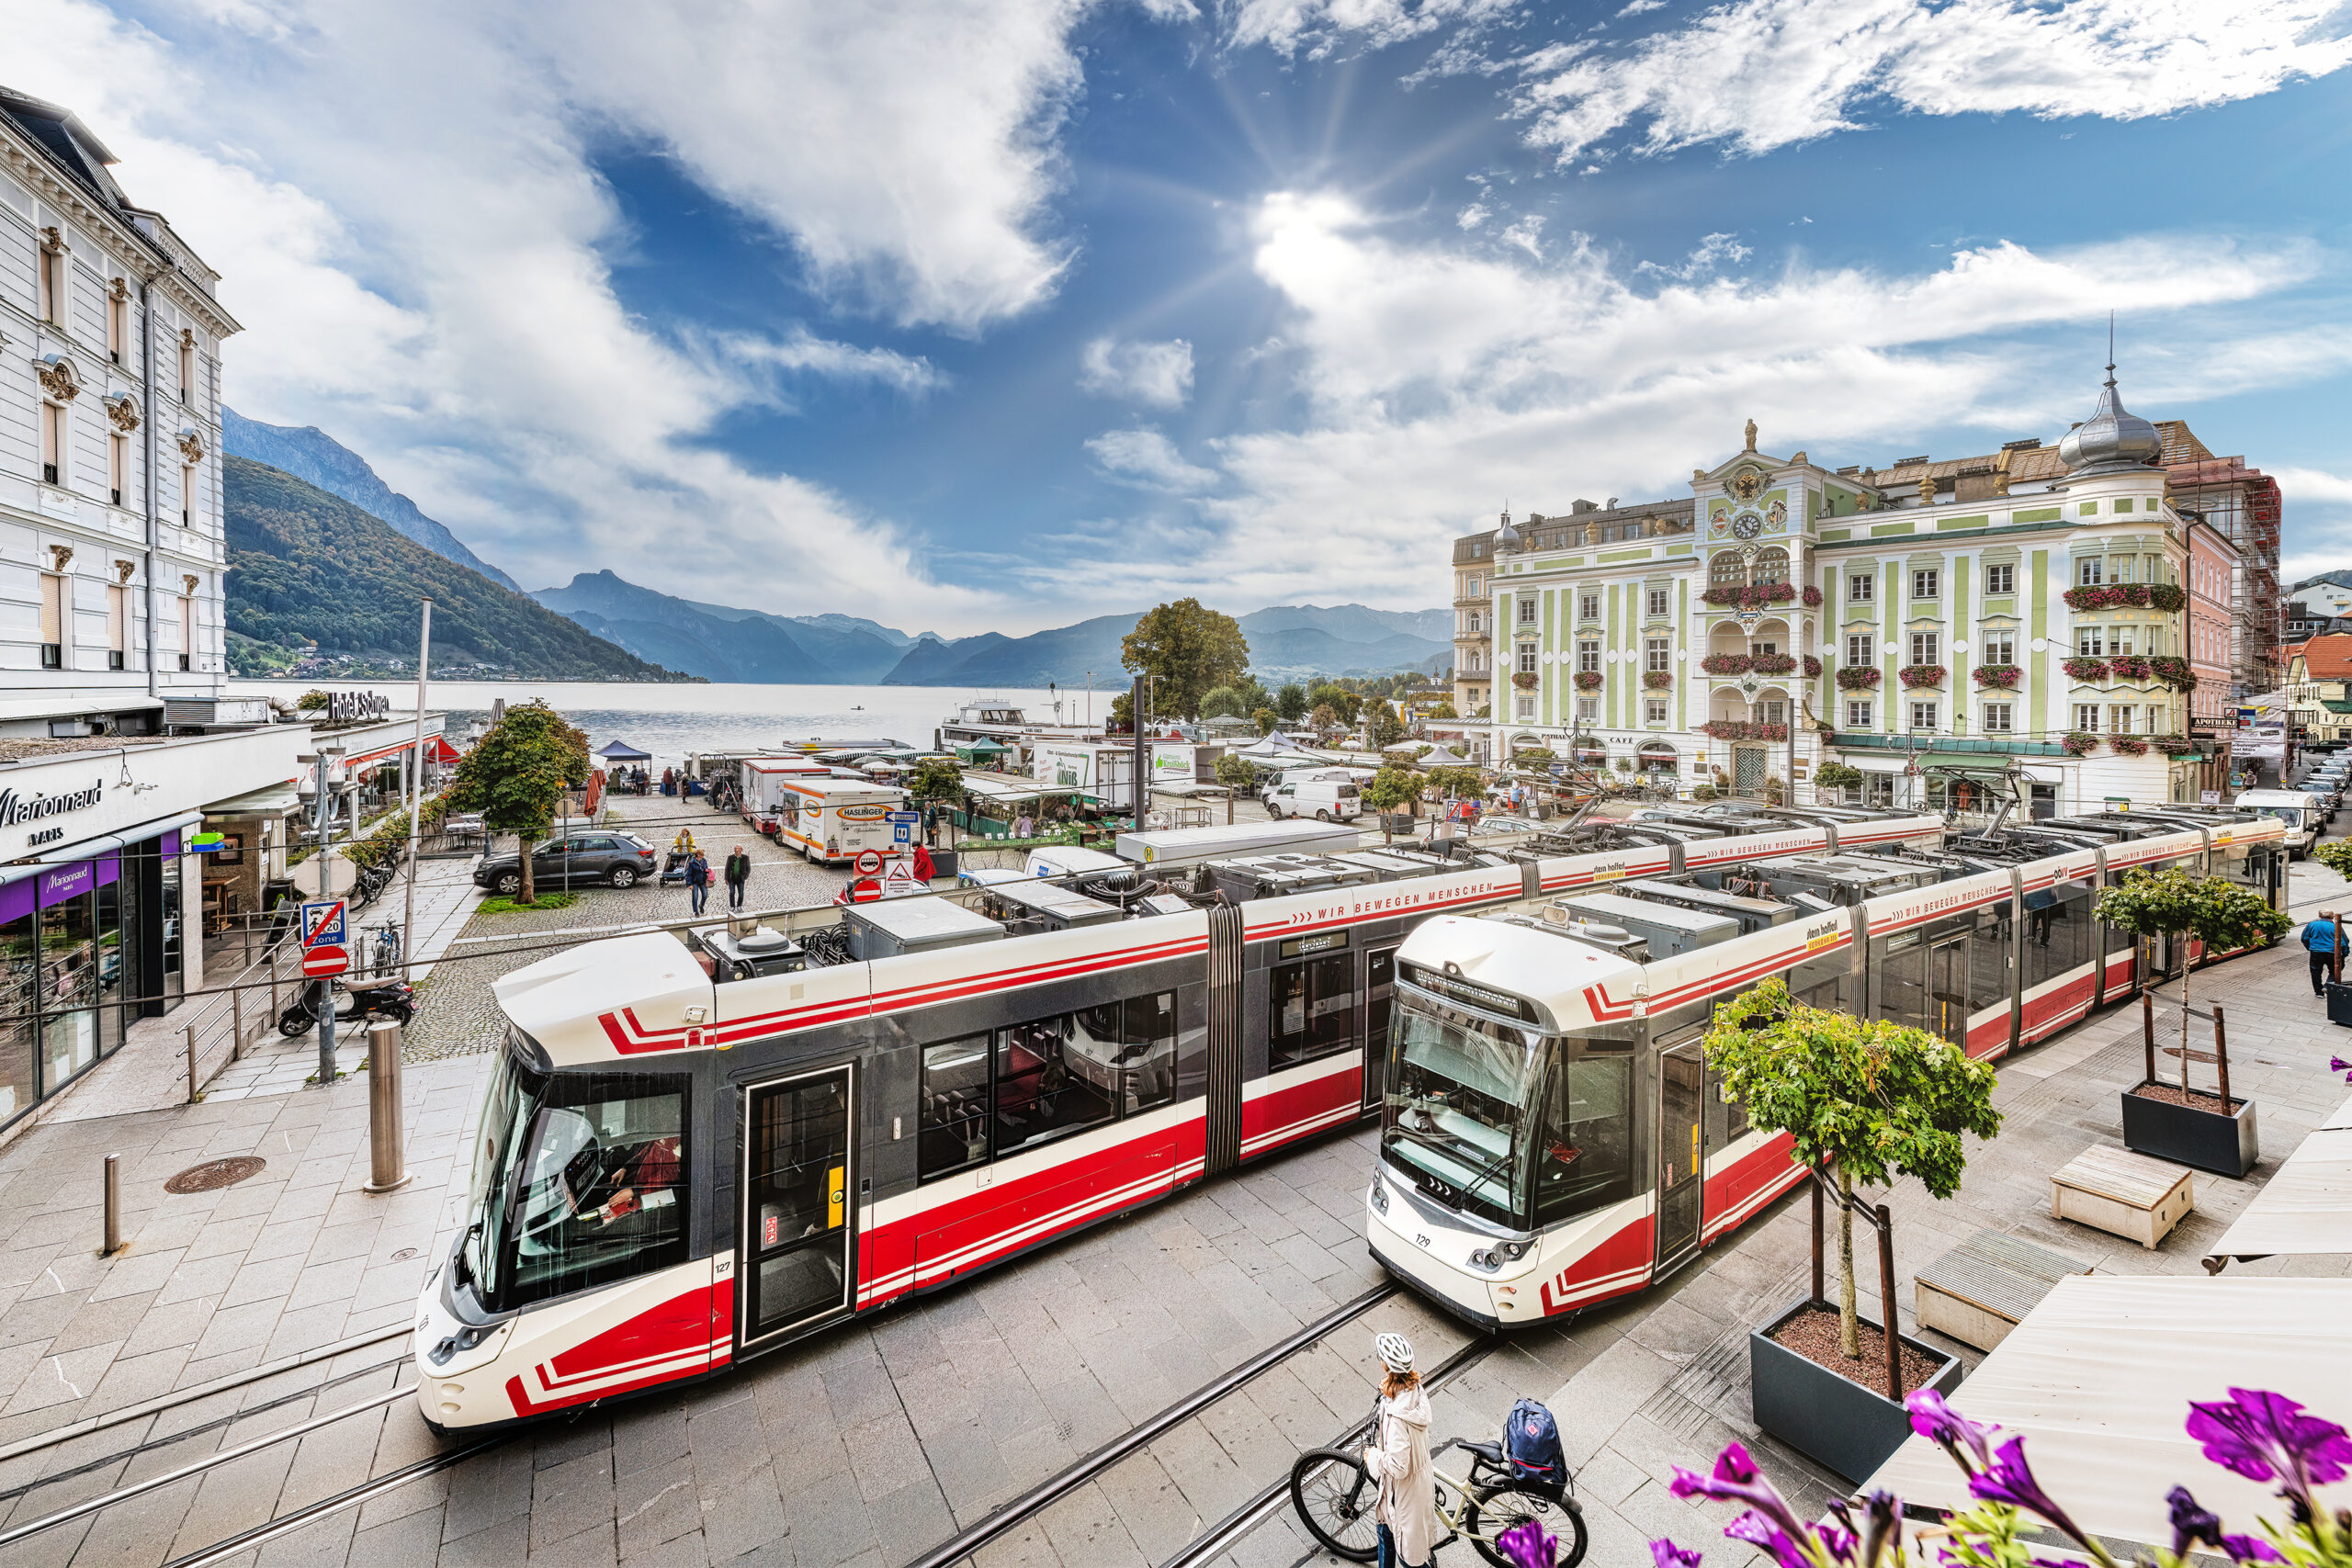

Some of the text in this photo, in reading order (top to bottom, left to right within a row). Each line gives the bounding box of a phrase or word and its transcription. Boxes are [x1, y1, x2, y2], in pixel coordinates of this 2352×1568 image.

[328, 691, 356, 719] Hotel
[1610, 736, 1634, 744] CAFÉ
[0, 778, 103, 827] Marionnaud
[1719, 838, 1811, 856] WIR BEWEGEN MENSCHEN
[46, 866, 88, 894] Marionnaud
[1317, 882, 1493, 919] WIR BEWEGEN MENSCHEN
[1905, 885, 1997, 917] WIR BEWEGEN MENSCHEN
[326, 921, 339, 931] 20
[312, 935, 338, 945] Zone
[1808, 936, 1830, 950] VERKEHR
[1416, 1233, 1430, 1248] 129
[715, 1260, 731, 1274] 127
